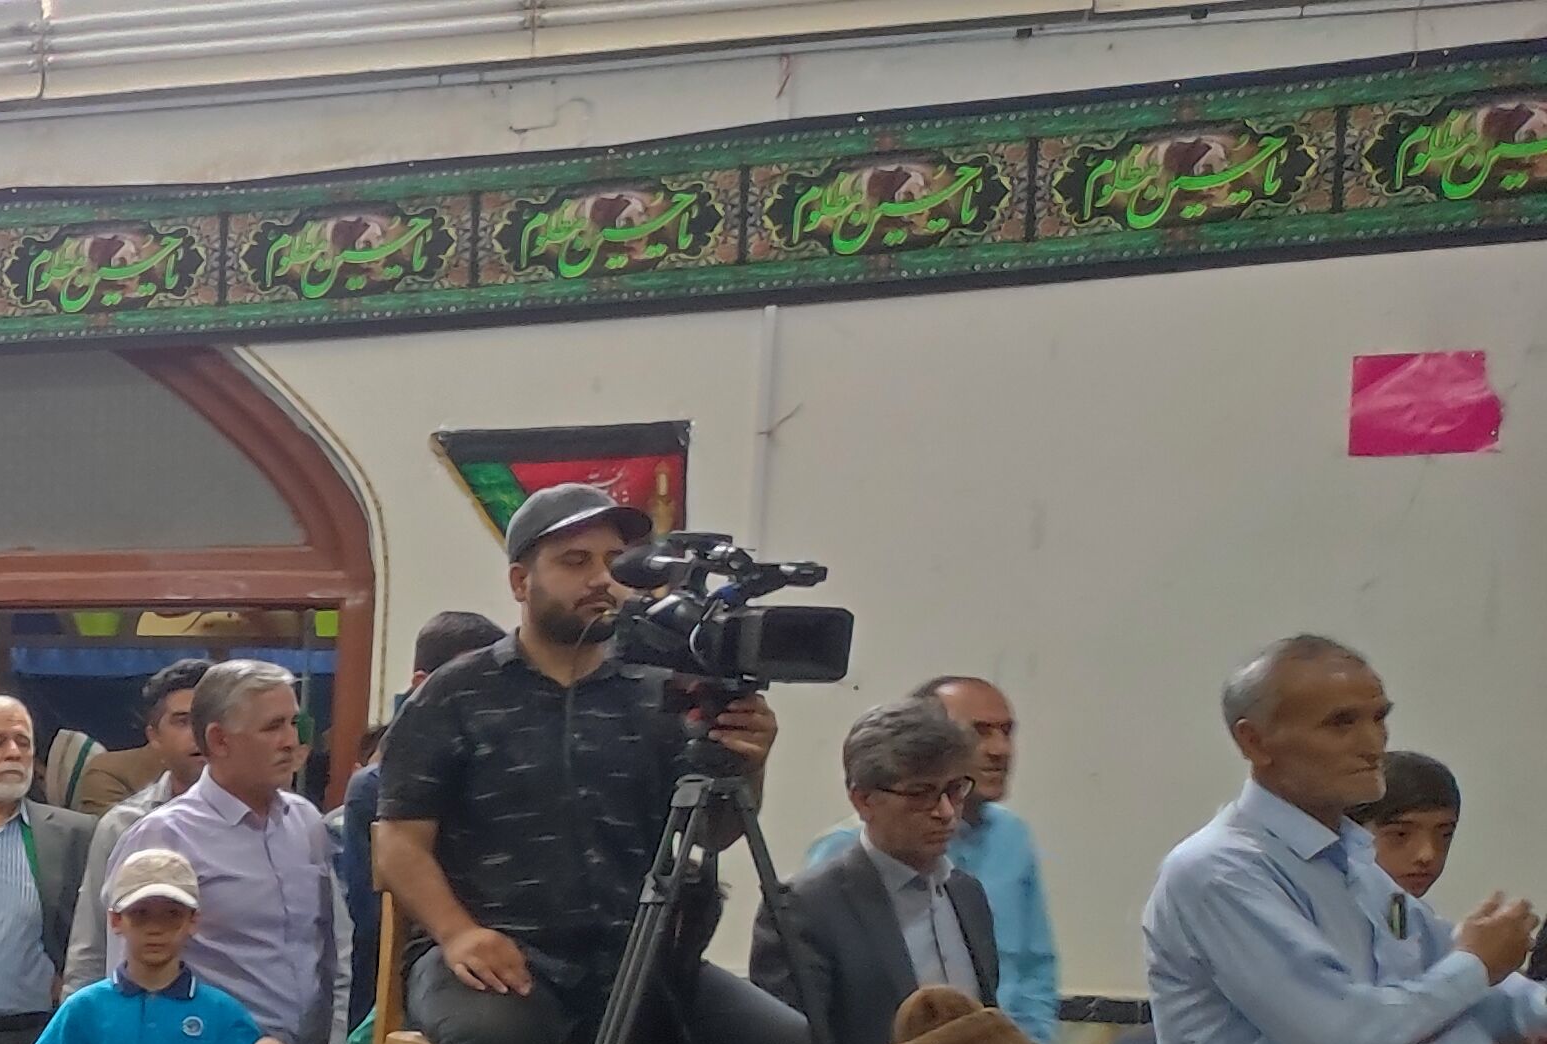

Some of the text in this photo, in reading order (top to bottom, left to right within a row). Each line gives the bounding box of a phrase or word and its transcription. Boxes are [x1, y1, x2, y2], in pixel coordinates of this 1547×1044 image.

[833, 165, 983, 255] حسین
[1127, 135, 1287, 230] حسین
[59, 235, 183, 313] حسین
[301, 217, 433, 298] حسین
[558, 192, 697, 279] حسین
